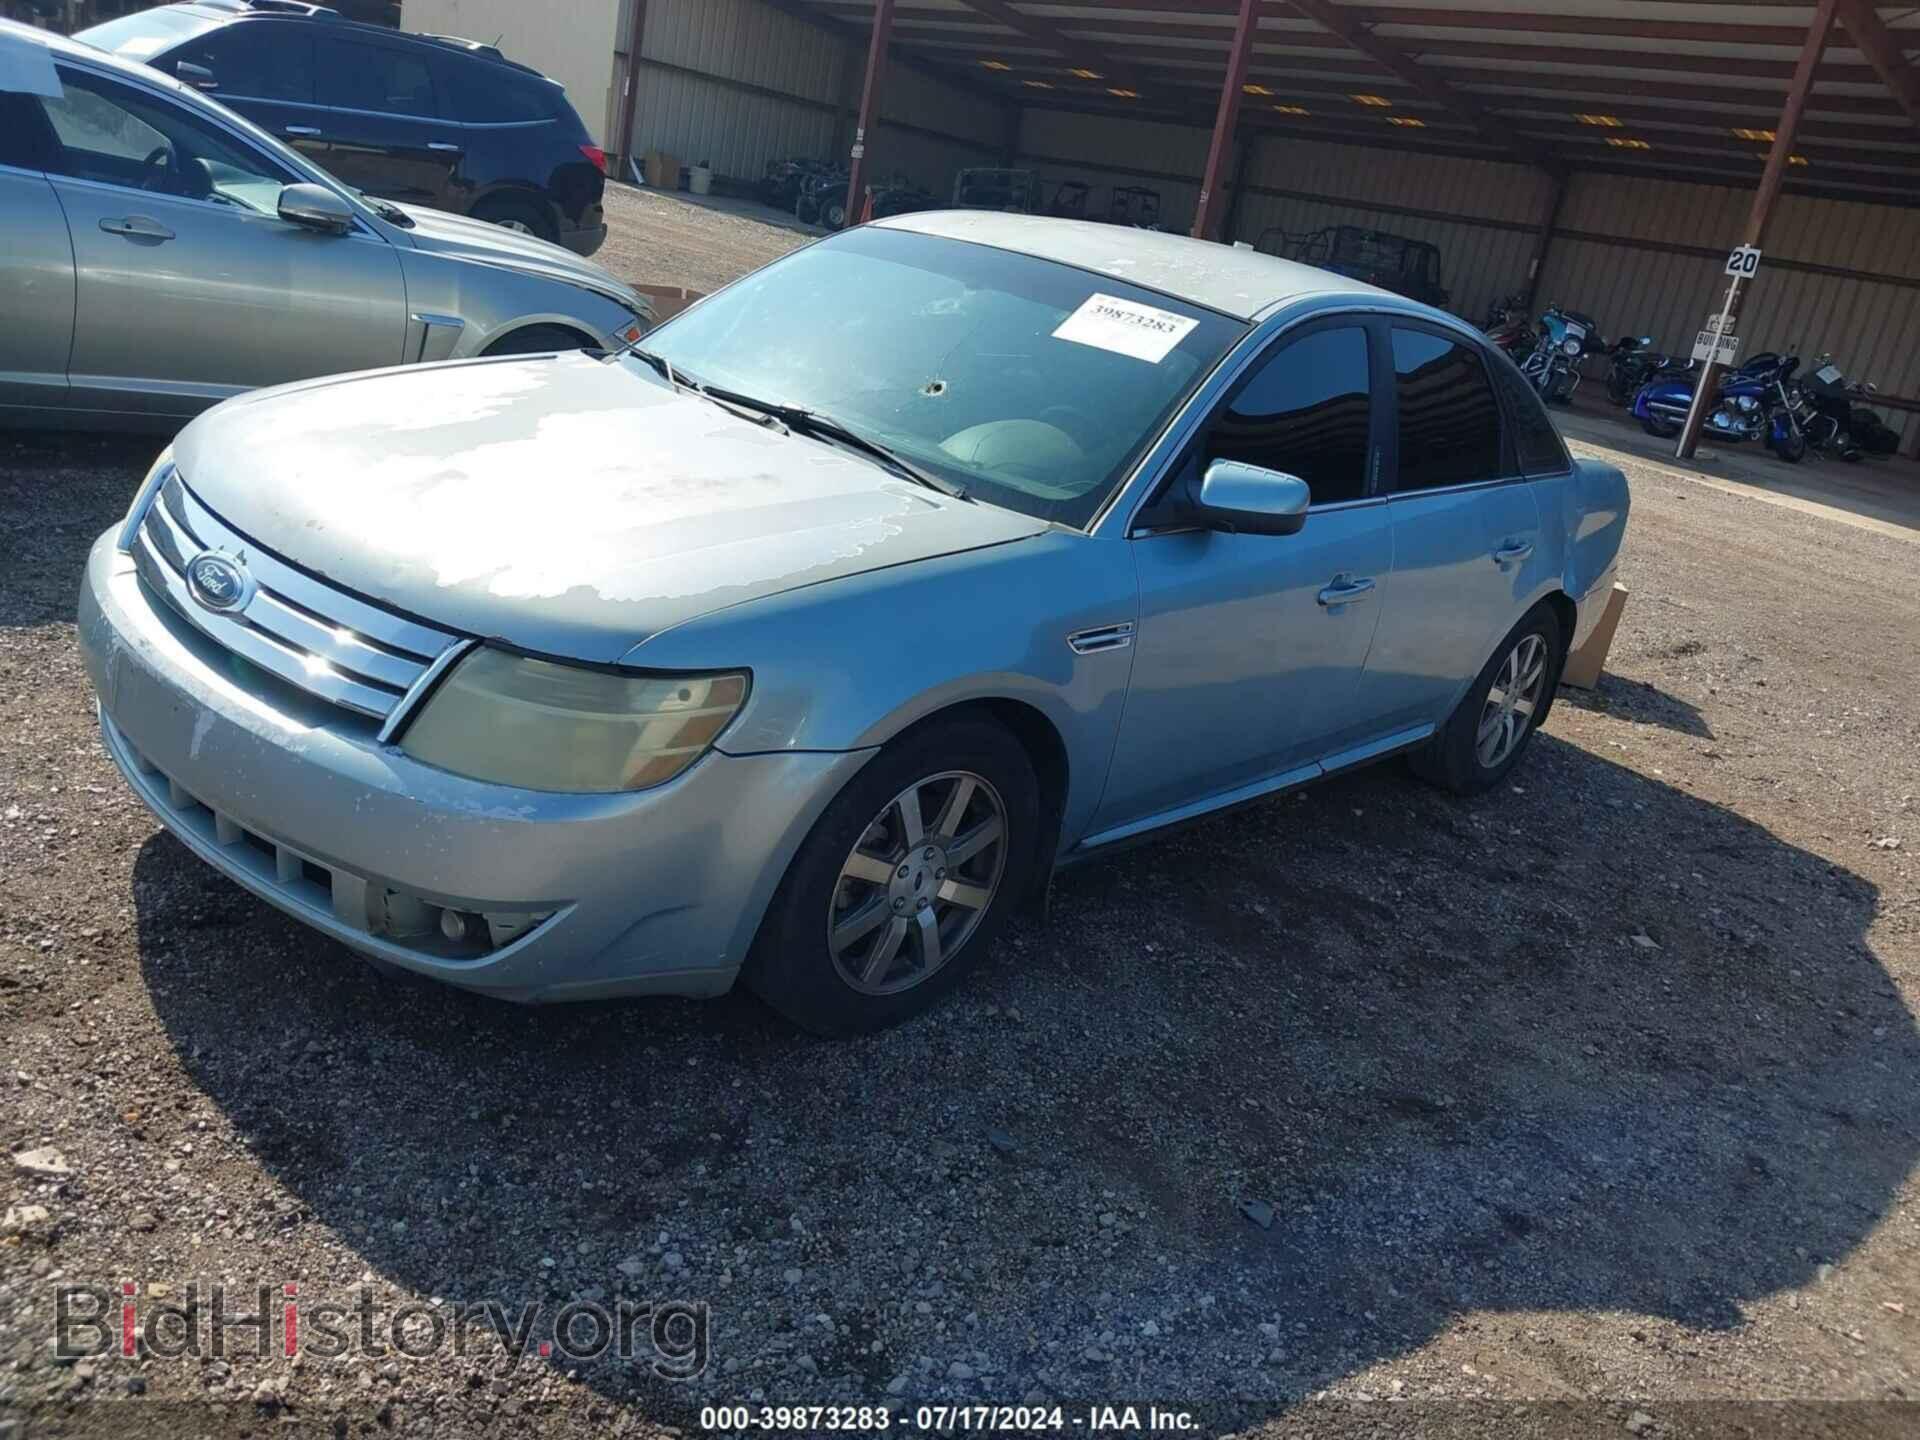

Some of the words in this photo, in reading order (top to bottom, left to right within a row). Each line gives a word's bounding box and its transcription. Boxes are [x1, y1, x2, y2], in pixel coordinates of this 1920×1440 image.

[1729, 251, 1757, 273] 20
[1090, 304, 1176, 333] 39873283
[198, 564, 228, 594] Ford
